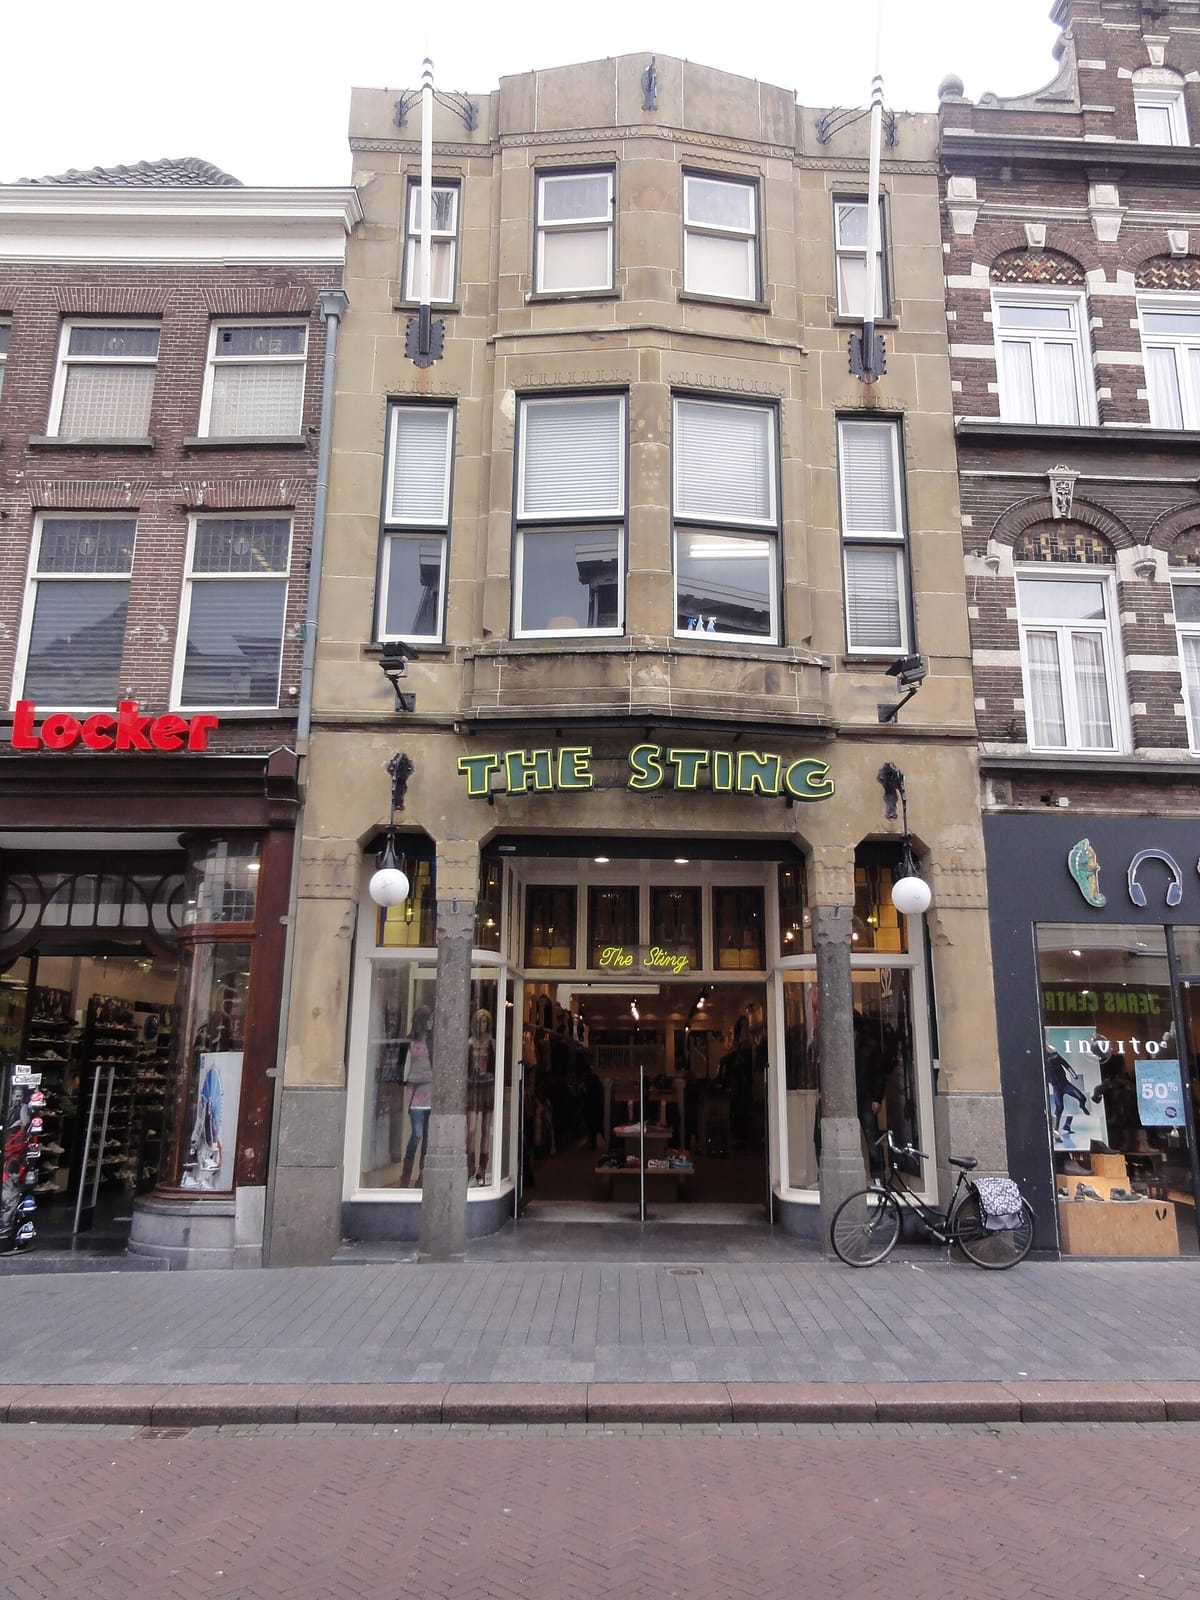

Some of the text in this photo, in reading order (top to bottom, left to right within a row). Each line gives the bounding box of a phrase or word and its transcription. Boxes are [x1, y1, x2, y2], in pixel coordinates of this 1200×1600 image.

[11, 700, 219, 752] Locker
[458, 743, 835, 802] THE STING
[599, 946, 689, 974] The Sting
[1141, 1081, 1178, 1099] 50%
